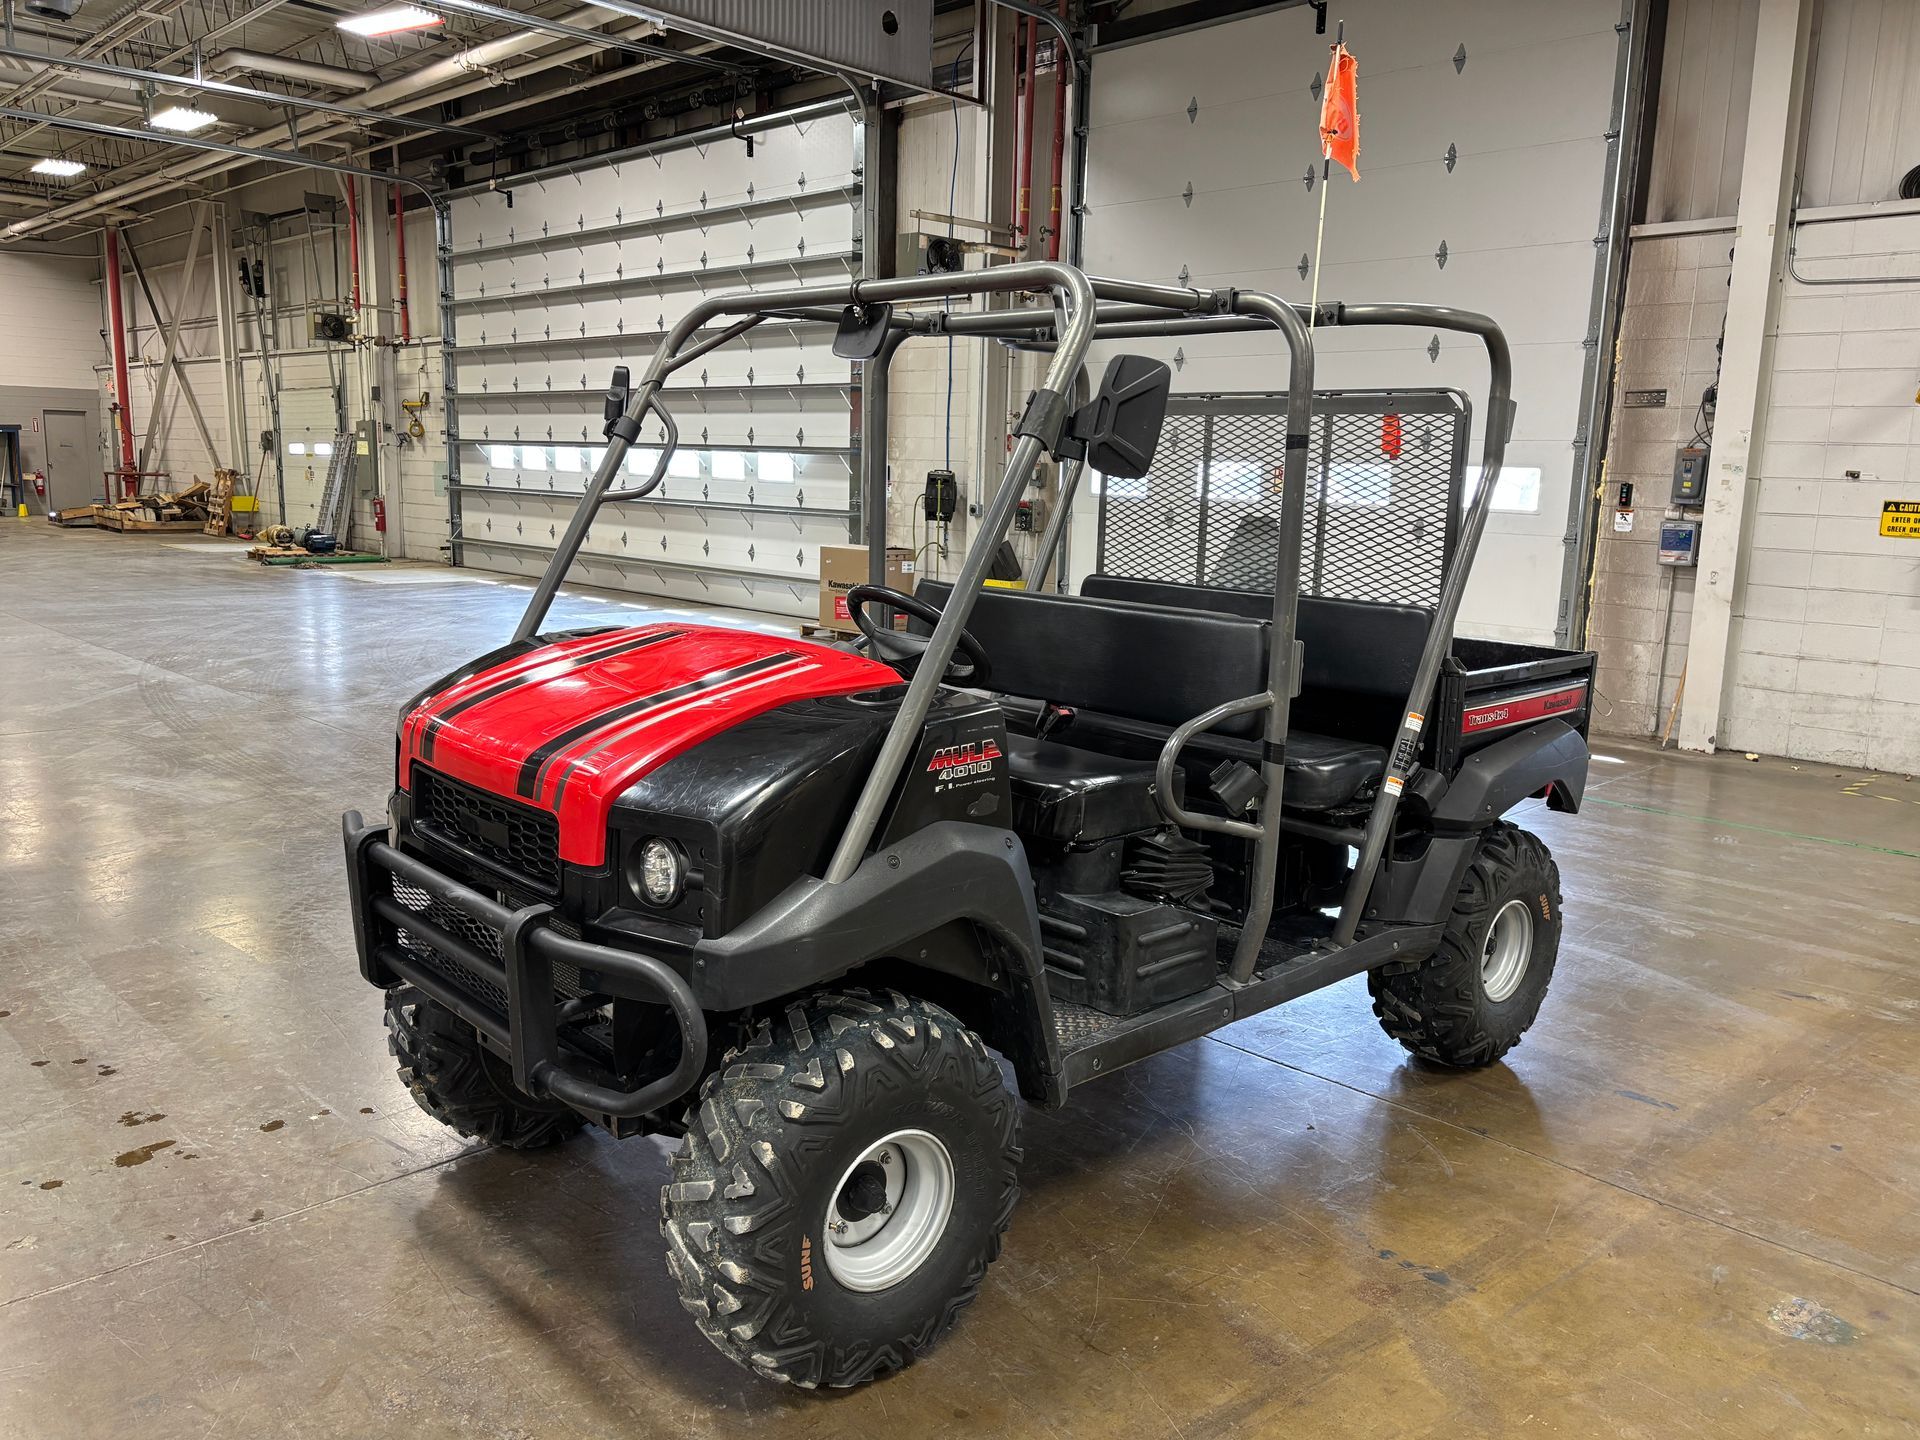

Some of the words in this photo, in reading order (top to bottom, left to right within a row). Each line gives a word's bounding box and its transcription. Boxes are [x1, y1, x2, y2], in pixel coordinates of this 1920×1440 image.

[1887, 525, 1906, 533] GREEN
[1891, 516, 1911, 524] ENTER
[1543, 695, 1573, 710] Kawasaki
[1468, 708, 1509, 726] Trans4x4
[926, 739, 1003, 772] MULE
[938, 760, 992, 780] 4010
[1539, 893, 1551, 921] SUNF
[801, 1233, 814, 1291] SUNF
